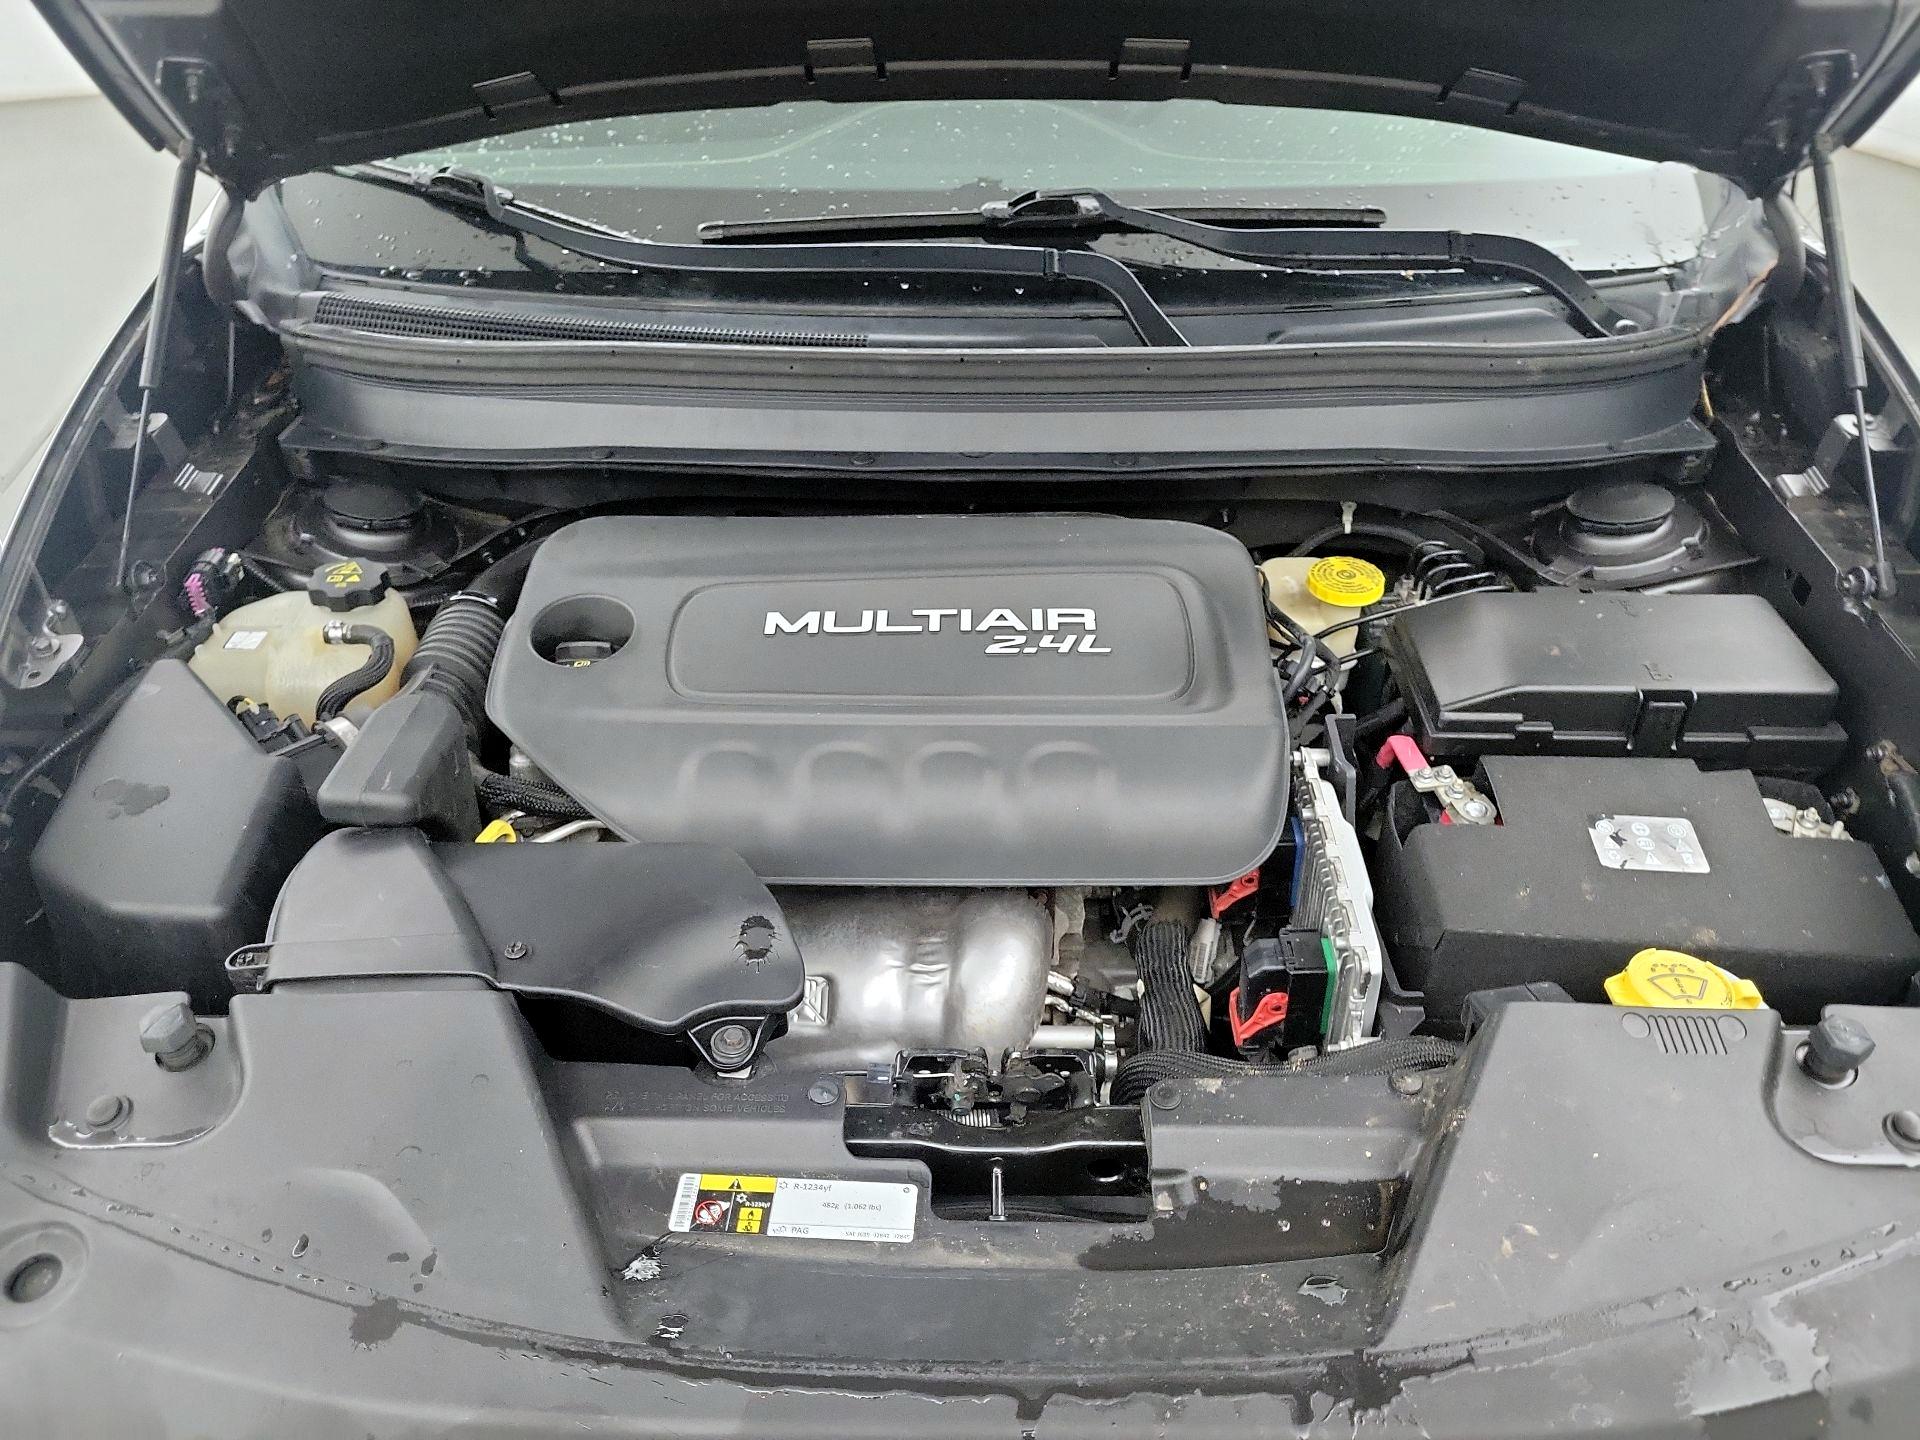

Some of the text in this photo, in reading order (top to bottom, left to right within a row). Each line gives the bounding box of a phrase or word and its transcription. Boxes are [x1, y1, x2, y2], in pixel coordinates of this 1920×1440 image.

[764, 608, 1097, 634] MULTIAIR
[984, 634, 1113, 654] 2.4L
[793, 1183, 832, 1192] R-1234yf
[791, 1227, 809, 1235] PAG
